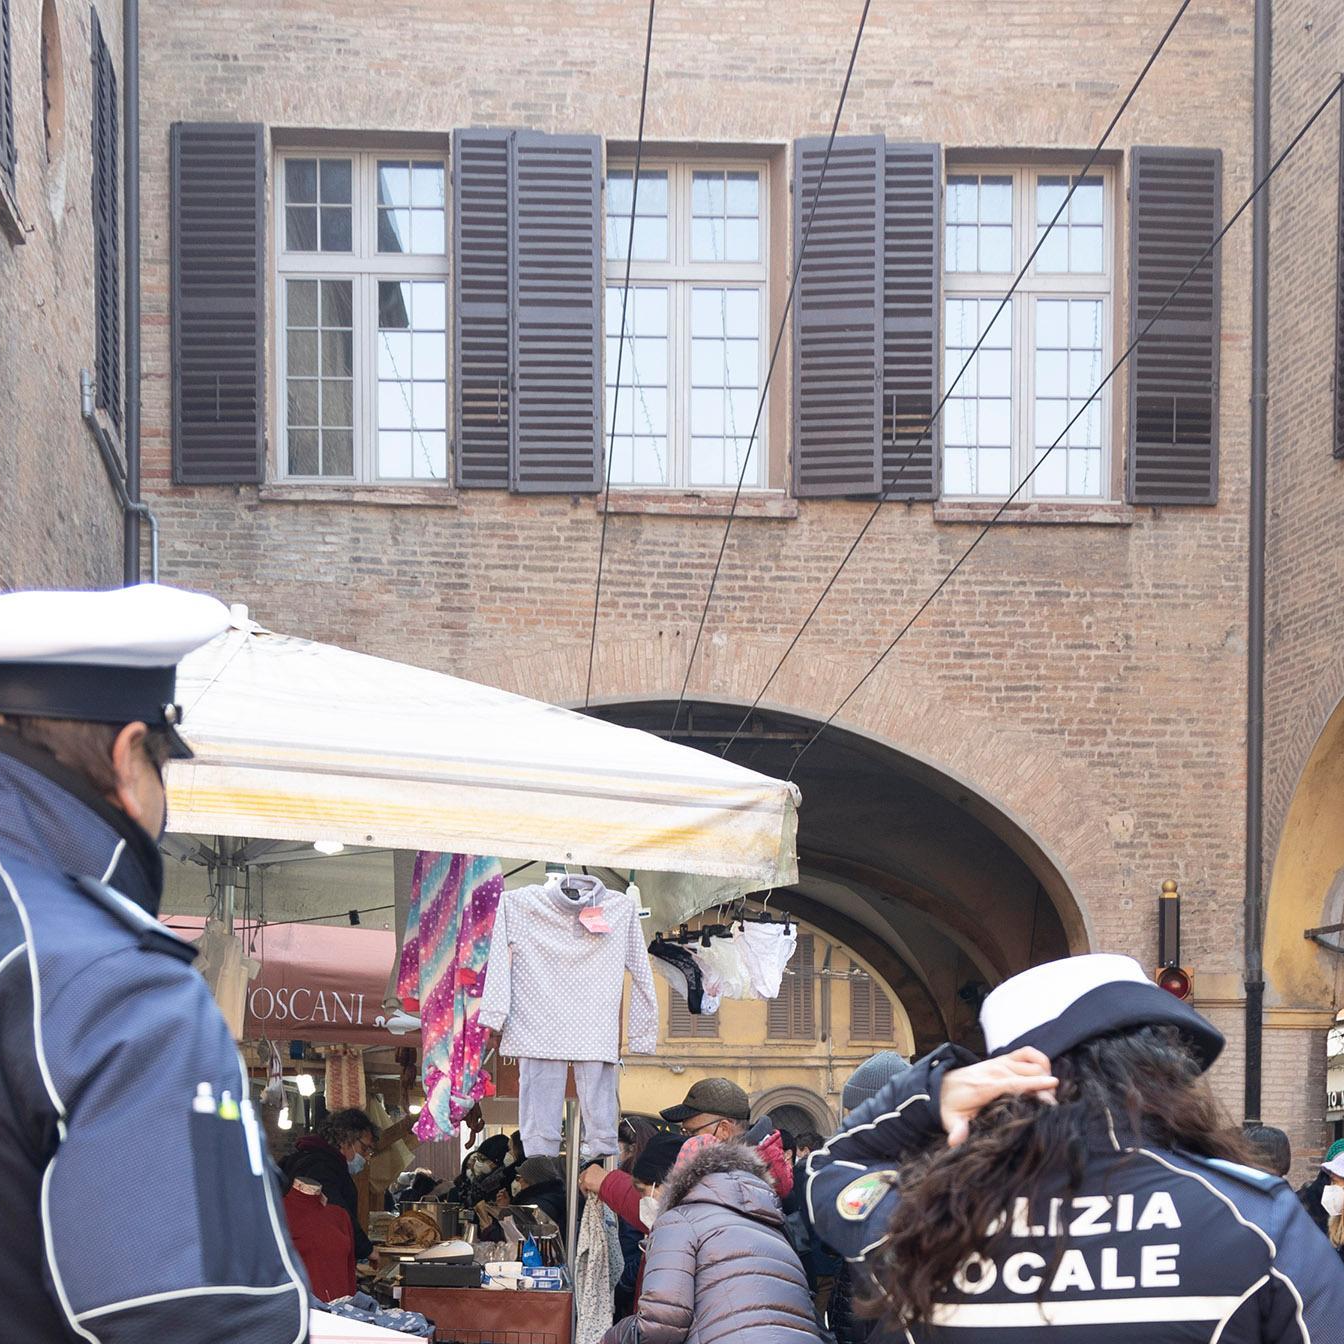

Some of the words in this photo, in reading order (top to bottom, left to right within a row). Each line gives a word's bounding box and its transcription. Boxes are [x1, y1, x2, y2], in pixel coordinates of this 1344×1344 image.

[247, 987, 365, 1025] OSCANI
[986, 1191, 1182, 1237] LIZIA
[953, 1243, 1181, 1295] OCALE
